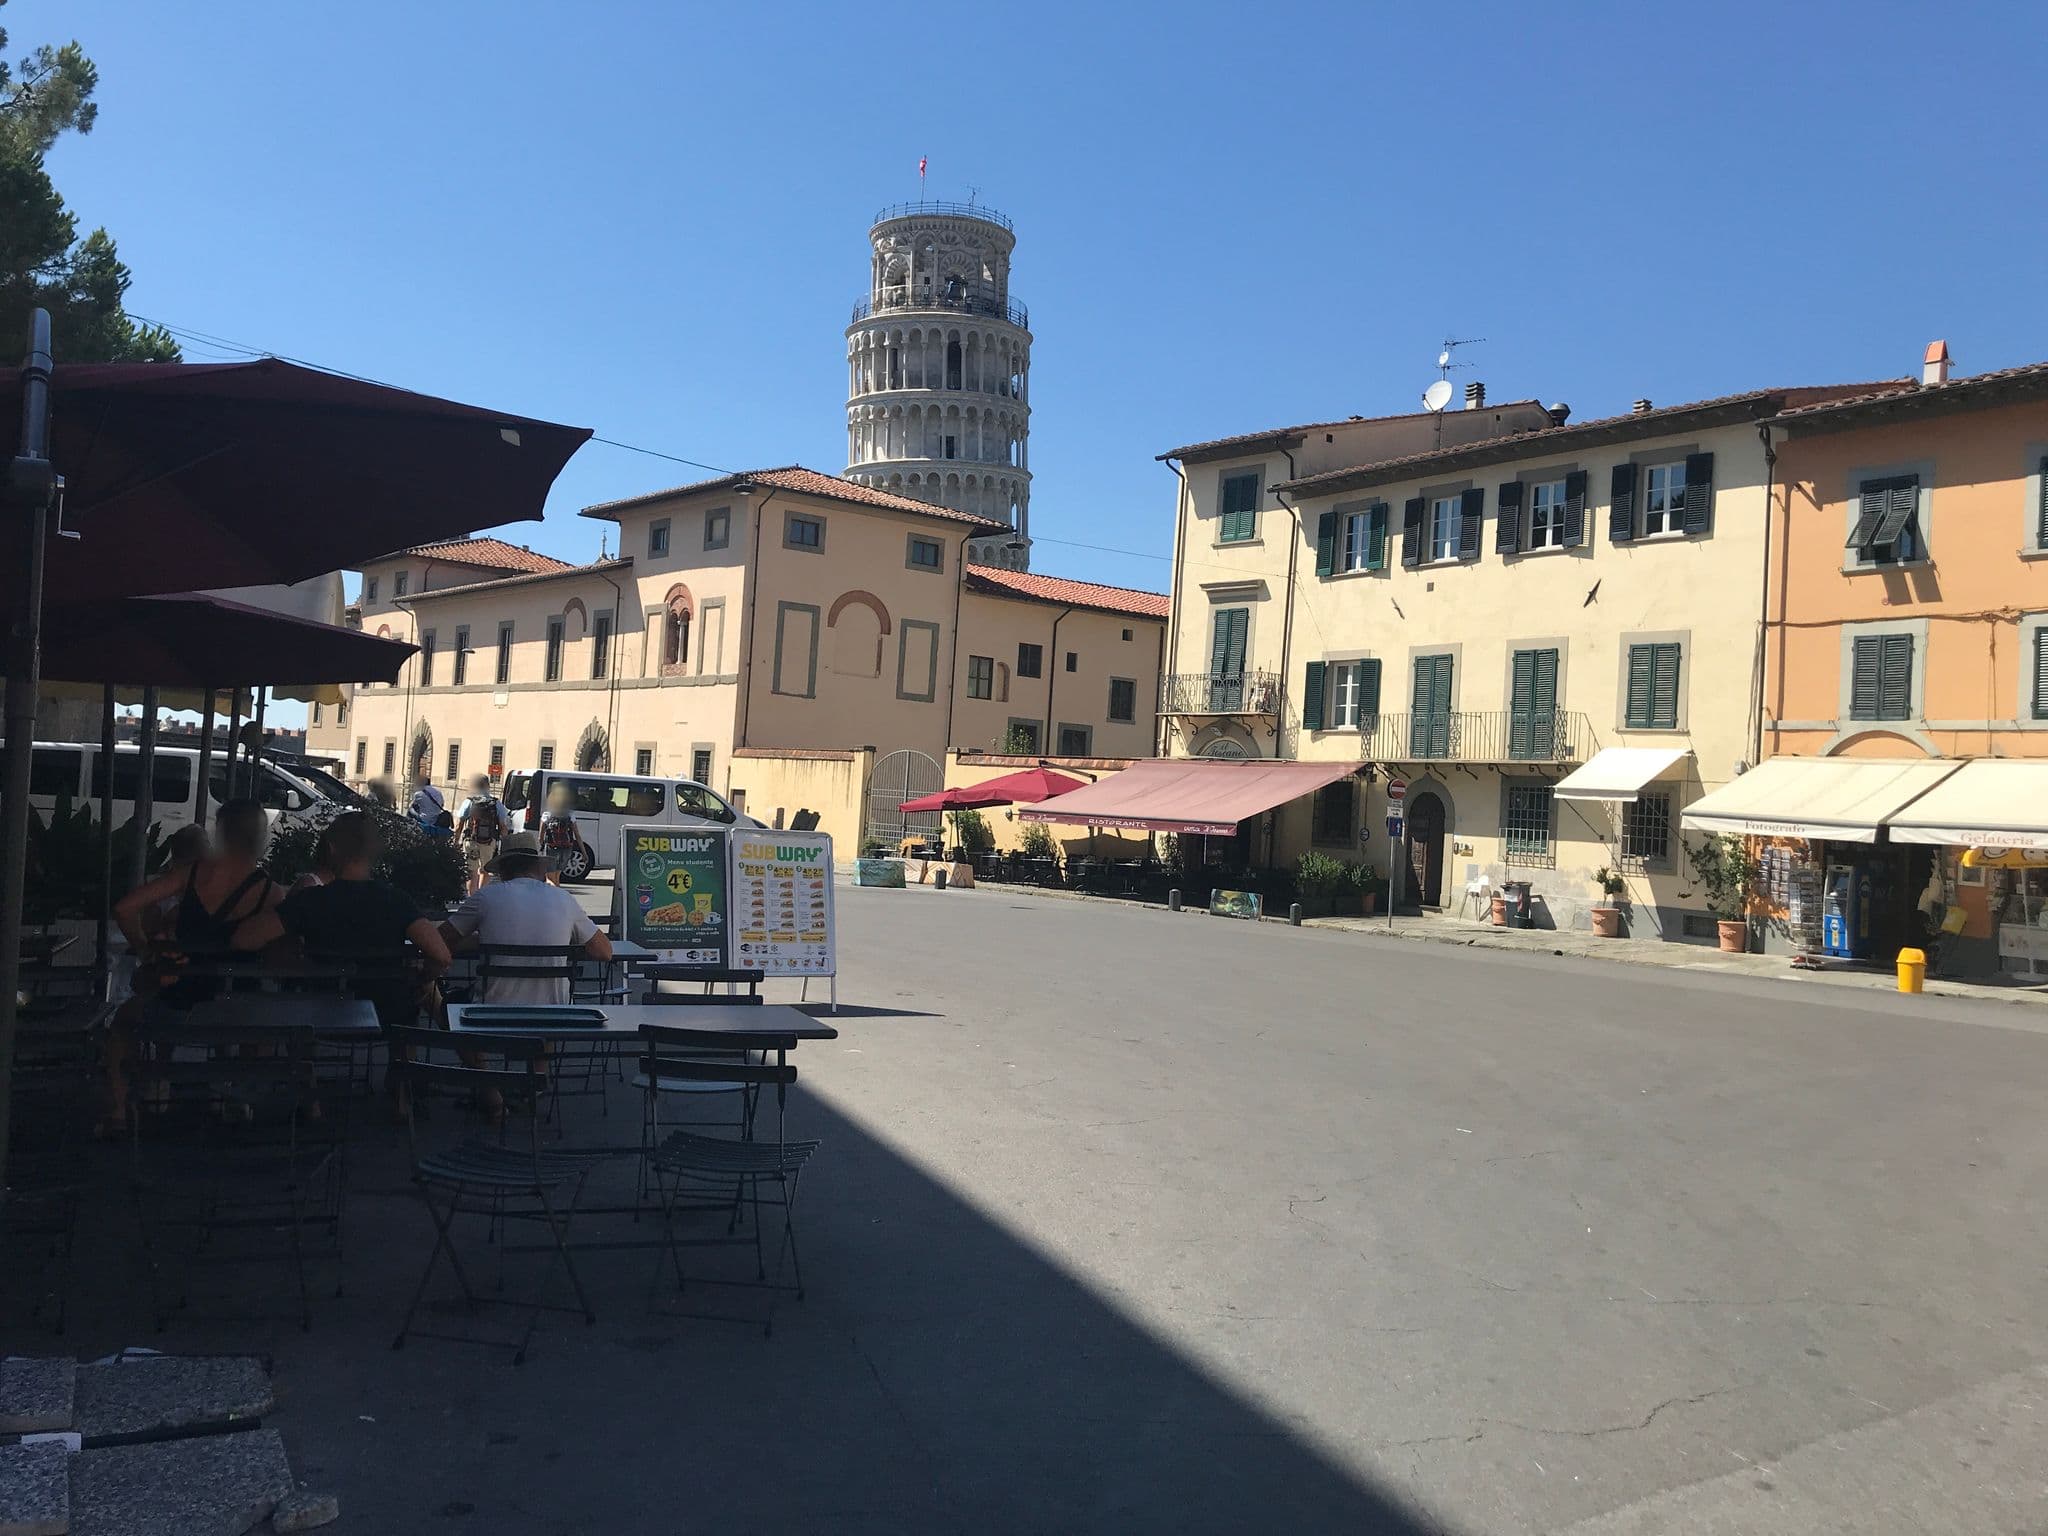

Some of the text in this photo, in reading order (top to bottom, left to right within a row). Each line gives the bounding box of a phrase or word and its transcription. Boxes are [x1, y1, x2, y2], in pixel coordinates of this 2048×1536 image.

[1088, 818, 1148, 828] RISTORANTE
[1745, 820, 1806, 833] Fotografo
[635, 836, 716, 852] SUBWAY
[1960, 831, 2034, 846] Gelateria
[739, 842, 824, 862] SUBWAY
